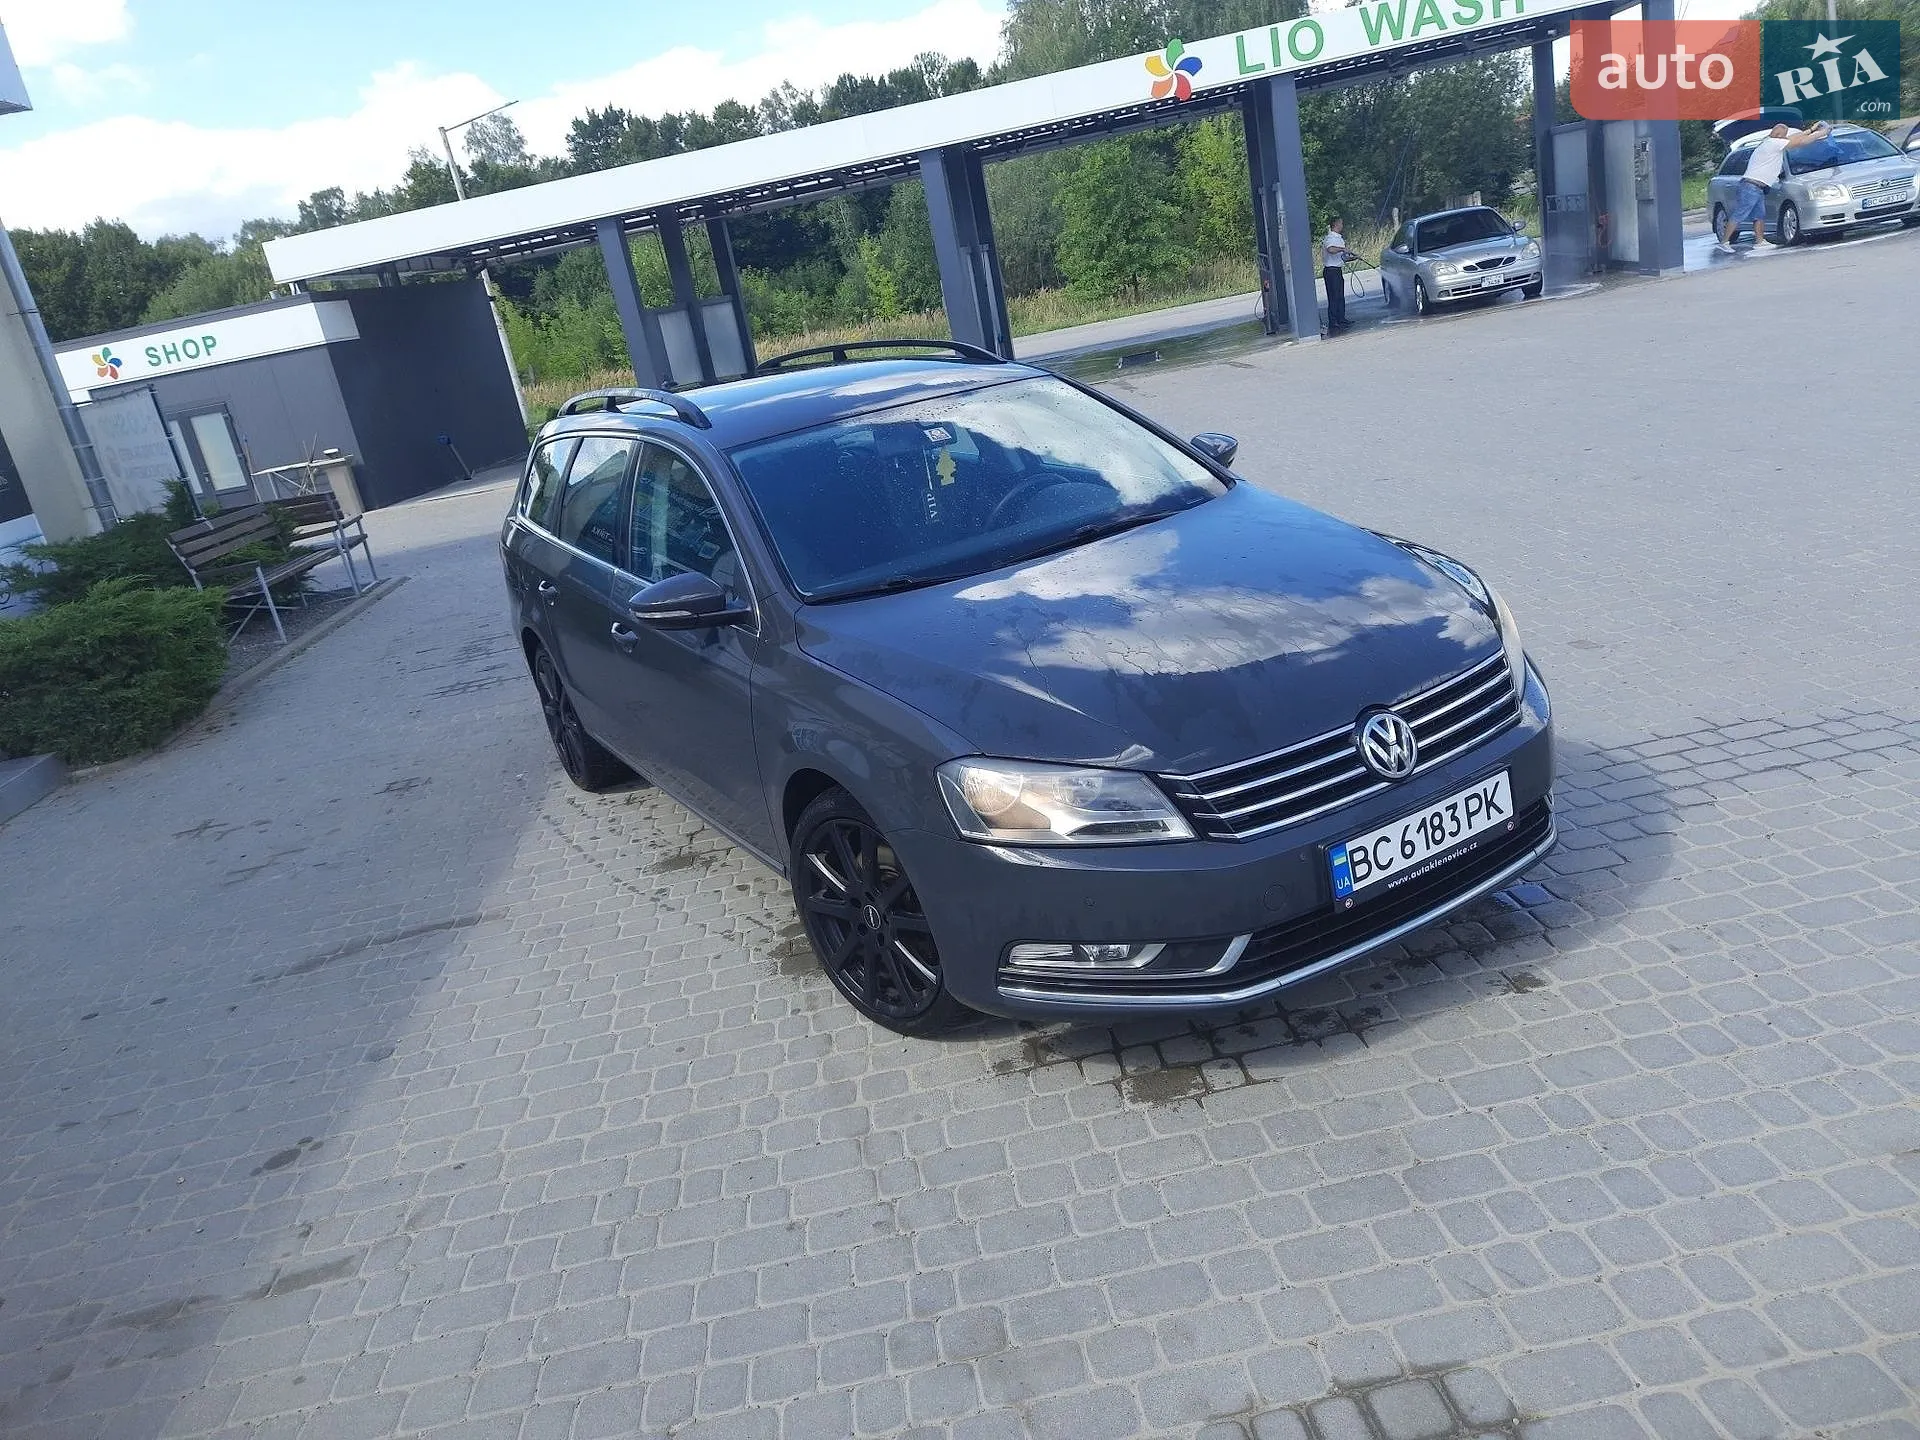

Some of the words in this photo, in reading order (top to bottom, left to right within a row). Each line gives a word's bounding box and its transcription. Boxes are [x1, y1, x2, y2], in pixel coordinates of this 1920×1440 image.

[1235, 19, 1324, 76] LIO
[144, 335, 217, 367] SHOP
[1348, 836, 1395, 884] BC
[1400, 801, 1461, 861] 6183
[1464, 780, 1504, 830] PK
[1336, 877, 1351, 890] UA
